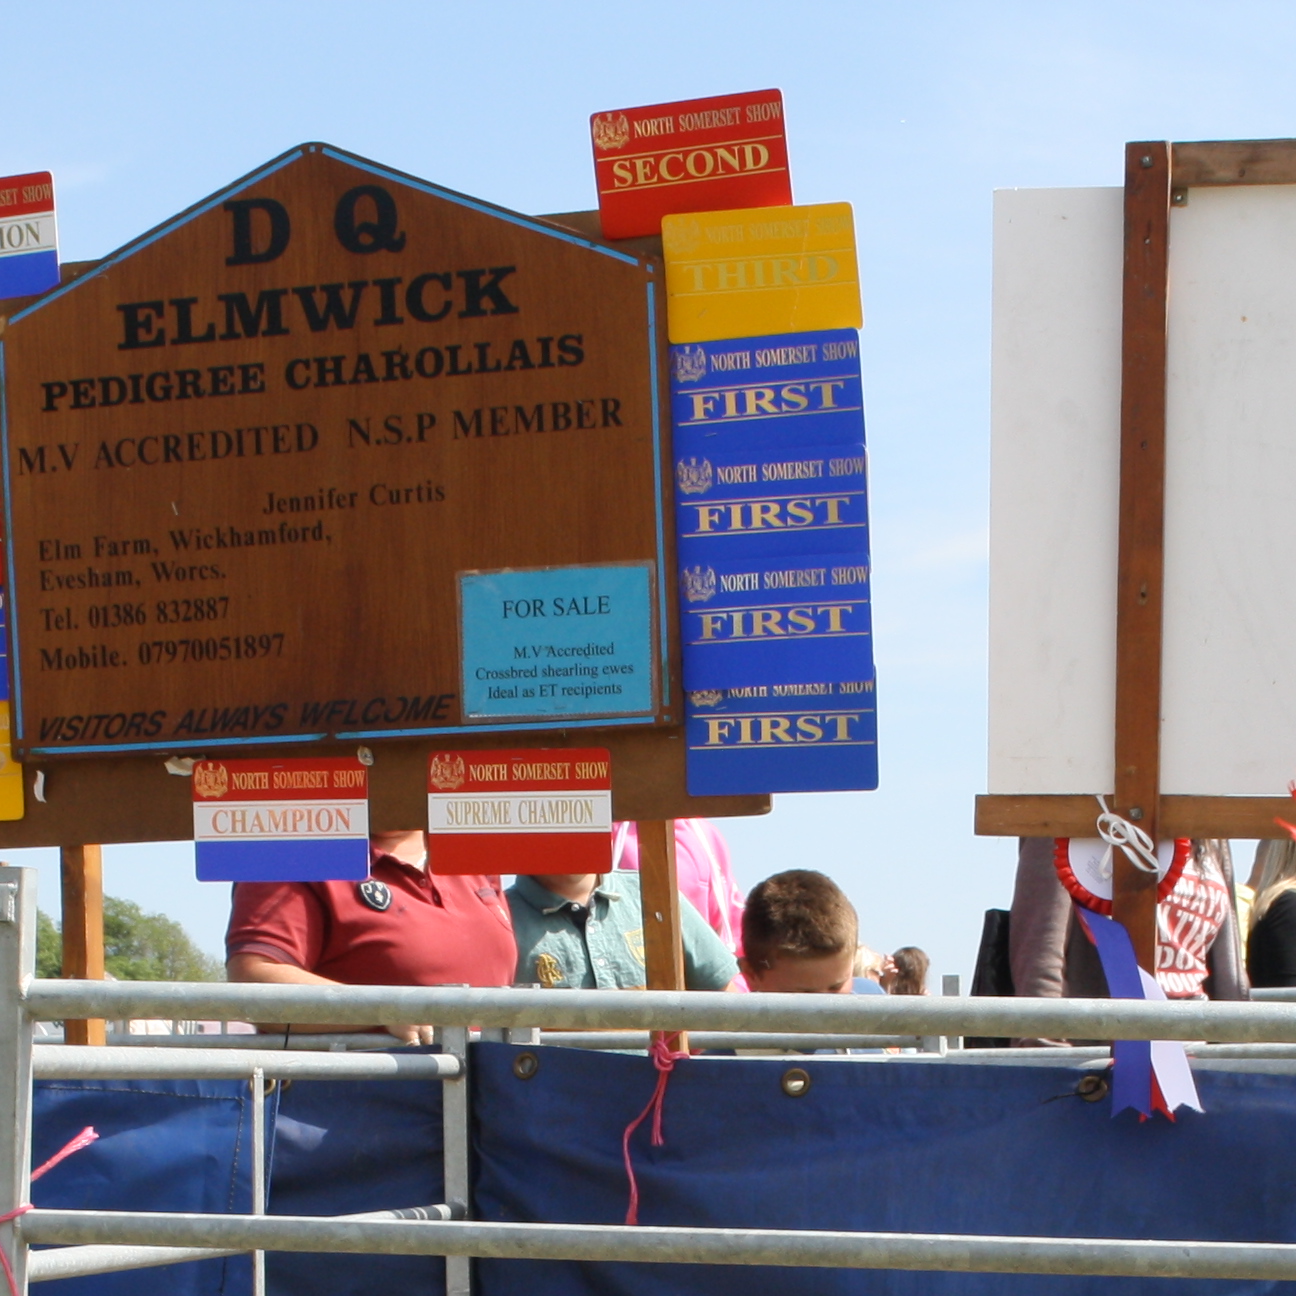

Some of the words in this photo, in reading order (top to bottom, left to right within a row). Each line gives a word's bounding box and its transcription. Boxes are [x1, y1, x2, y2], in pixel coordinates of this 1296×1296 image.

[633, 117, 674, 138] NORTH
[678, 107, 741, 132] SOMERSET
[746, 101, 782, 123] SHOW
[612, 143, 770, 188] SECOND
[22, 183, 52, 204] SHOW
[223, 197, 291, 267] D
[334, 184, 406, 255] Q
[704, 224, 745, 245] NORTH
[749, 218, 810, 242] SOMERSET
[683, 254, 839, 292] THIRD
[115, 265, 520, 352] ELMWICK
[40, 362, 267, 413] PEDIGREE
[285, 333, 586, 391] CHAROLLAIS
[710, 351, 751, 373] NORTH
[755, 345, 817, 369] SOMERSET
[822, 340, 858, 362] SHOW
[690, 381, 845, 421] FIRST
[17, 442, 81, 477] M.V
[94, 421, 320, 470] ACCREDITED
[347, 412, 437, 451] N.S.P
[452, 398, 624, 441] MEMBER
[717, 464, 757, 485] NORTH
[762, 460, 824, 482] SOMERSET
[829, 457, 865, 478] SHOW
[262, 487, 359, 515] Jennifer
[369, 480, 446, 507] Curtis
[694, 496, 850, 533] FIRST
[38, 539, 82, 562] Elm
[93, 534, 159, 559] Farm,
[169, 520, 333, 552] Wickhamford,
[40, 567, 141, 592] Evesham,
[151, 560, 227, 584] Worcs.
[720, 573, 759, 593] NORTH
[763, 568, 826, 590] SOMERSET
[831, 565, 868, 586] SHOW
[41, 607, 79, 632] Tel.
[88, 600, 147, 629] 01386
[156, 596, 230, 624] 832887
[502, 599, 546, 619] FOR
[553, 595, 611, 616] SALE
[698, 605, 853, 640] FIRST
[40, 645, 128, 672] Mobile.
[138, 633, 285, 665] 07970051897
[513, 645, 542, 659] M.V
[546, 642, 615, 659] Accredited
[475, 664, 538, 680] Crossbred
[541, 663, 599, 679] shearling
[602, 664, 634, 675] ewes
[488, 685, 518, 700] Ideal
[522, 687, 535, 698] as
[539, 684, 558, 697] ET
[561, 682, 622, 699] recipients
[38, 709, 167, 743] VISITORS
[173, 702, 289, 735] ALWAYS
[704, 714, 859, 745] FIRST
[231, 772, 269, 791] NORTH
[273, 770, 330, 789] SOMERSET
[332, 769, 366, 788] SHOW
[469, 763, 507, 782] NORTH
[512, 762, 571, 781] SOMERSET
[575, 761, 609, 780] SHOW
[211, 807, 351, 835] CHAMPION
[445, 800, 511, 825] SUPREME
[518, 798, 594, 825] CHAMPION
